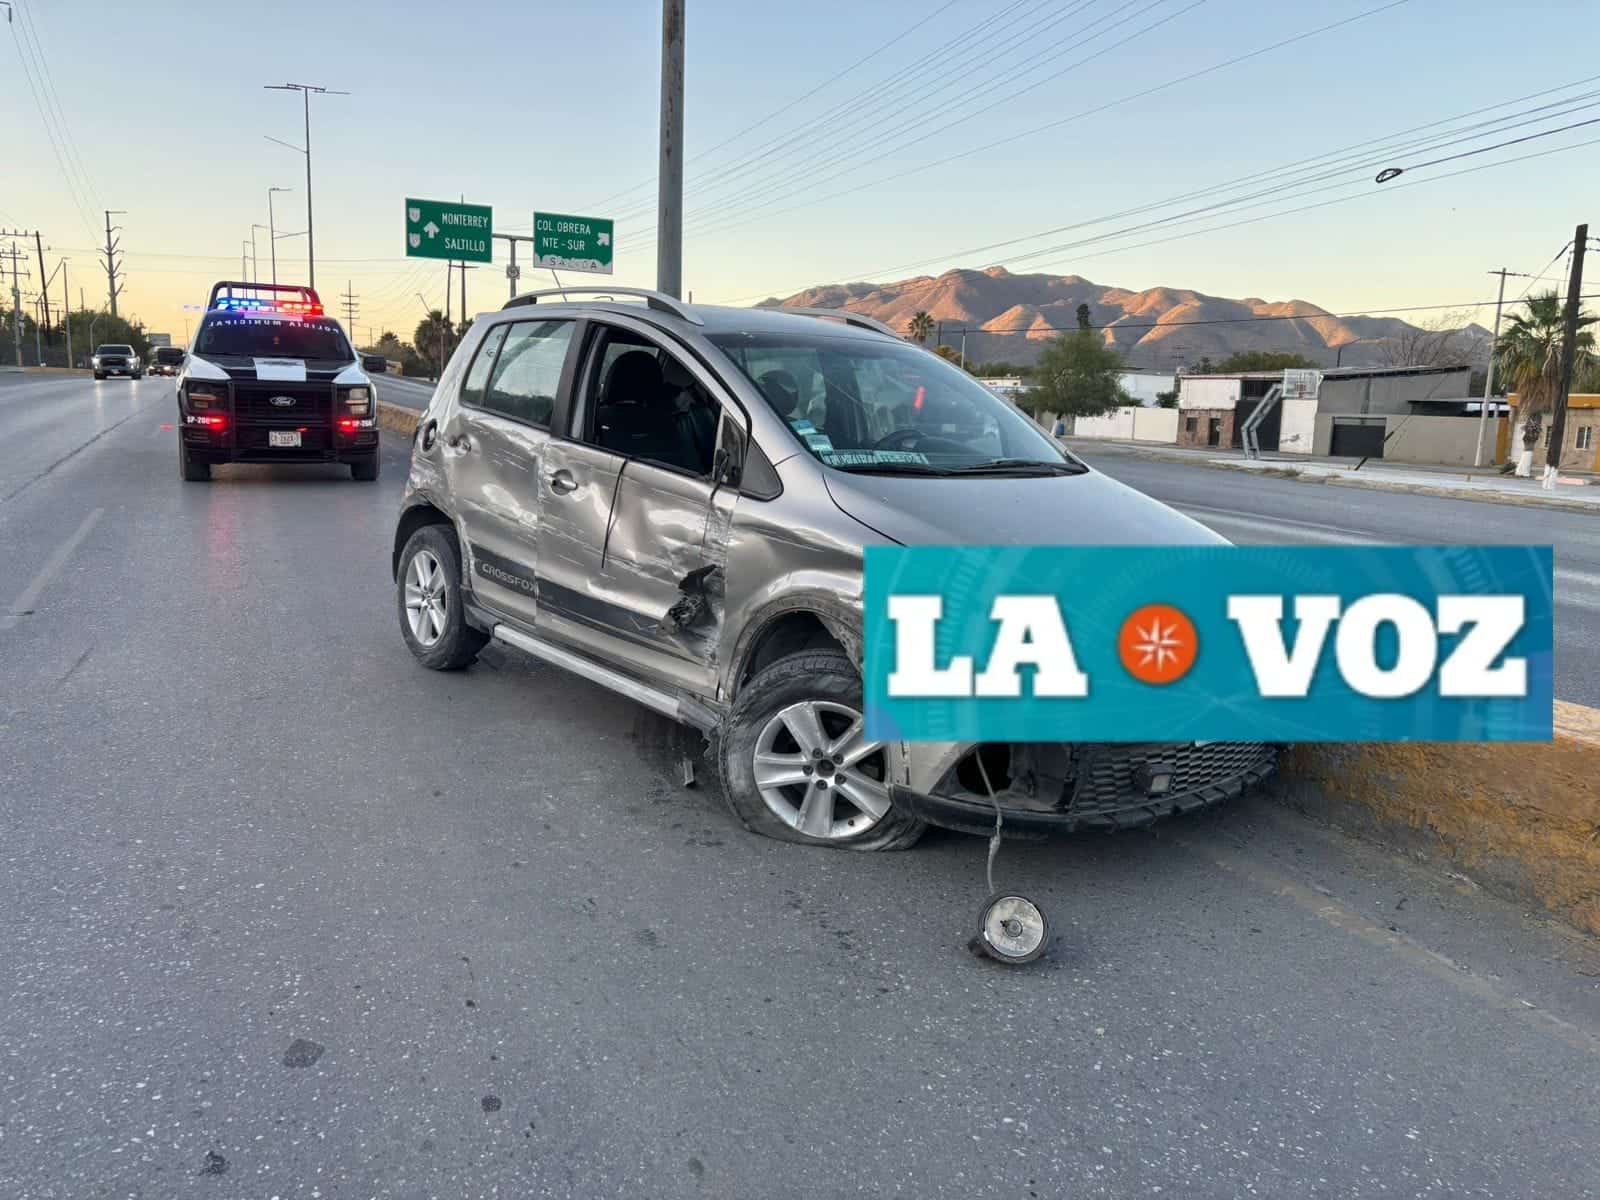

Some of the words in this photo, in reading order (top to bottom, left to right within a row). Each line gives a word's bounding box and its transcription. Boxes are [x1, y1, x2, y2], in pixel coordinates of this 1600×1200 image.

[442, 213, 489, 228] MONTERREY
[557, 221, 591, 235] OBRERA
[444, 237, 485, 252] SALTILLO
[482, 563, 537, 592] CROSSFOX
